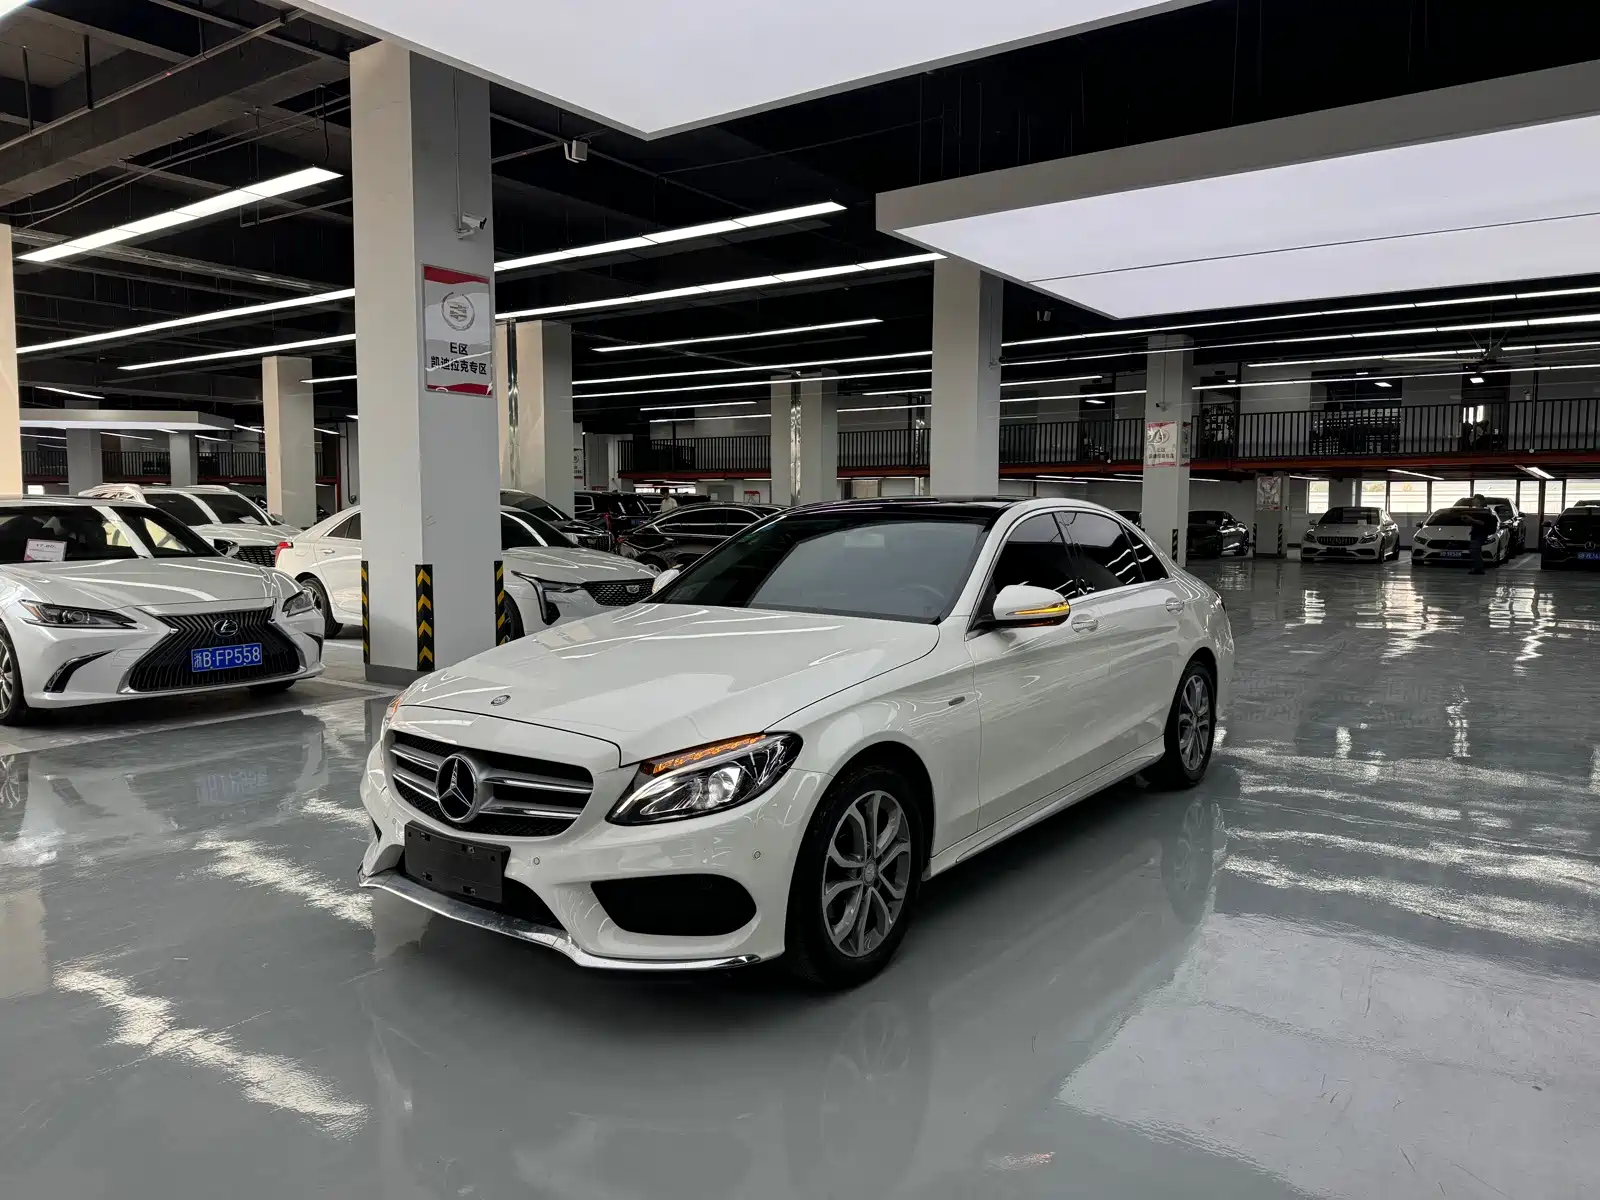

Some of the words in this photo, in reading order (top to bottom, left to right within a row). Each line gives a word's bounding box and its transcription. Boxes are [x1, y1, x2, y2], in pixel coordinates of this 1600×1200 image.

[450, 342, 468, 355] E区
[430, 355, 487, 375] 凯迪拉克专区
